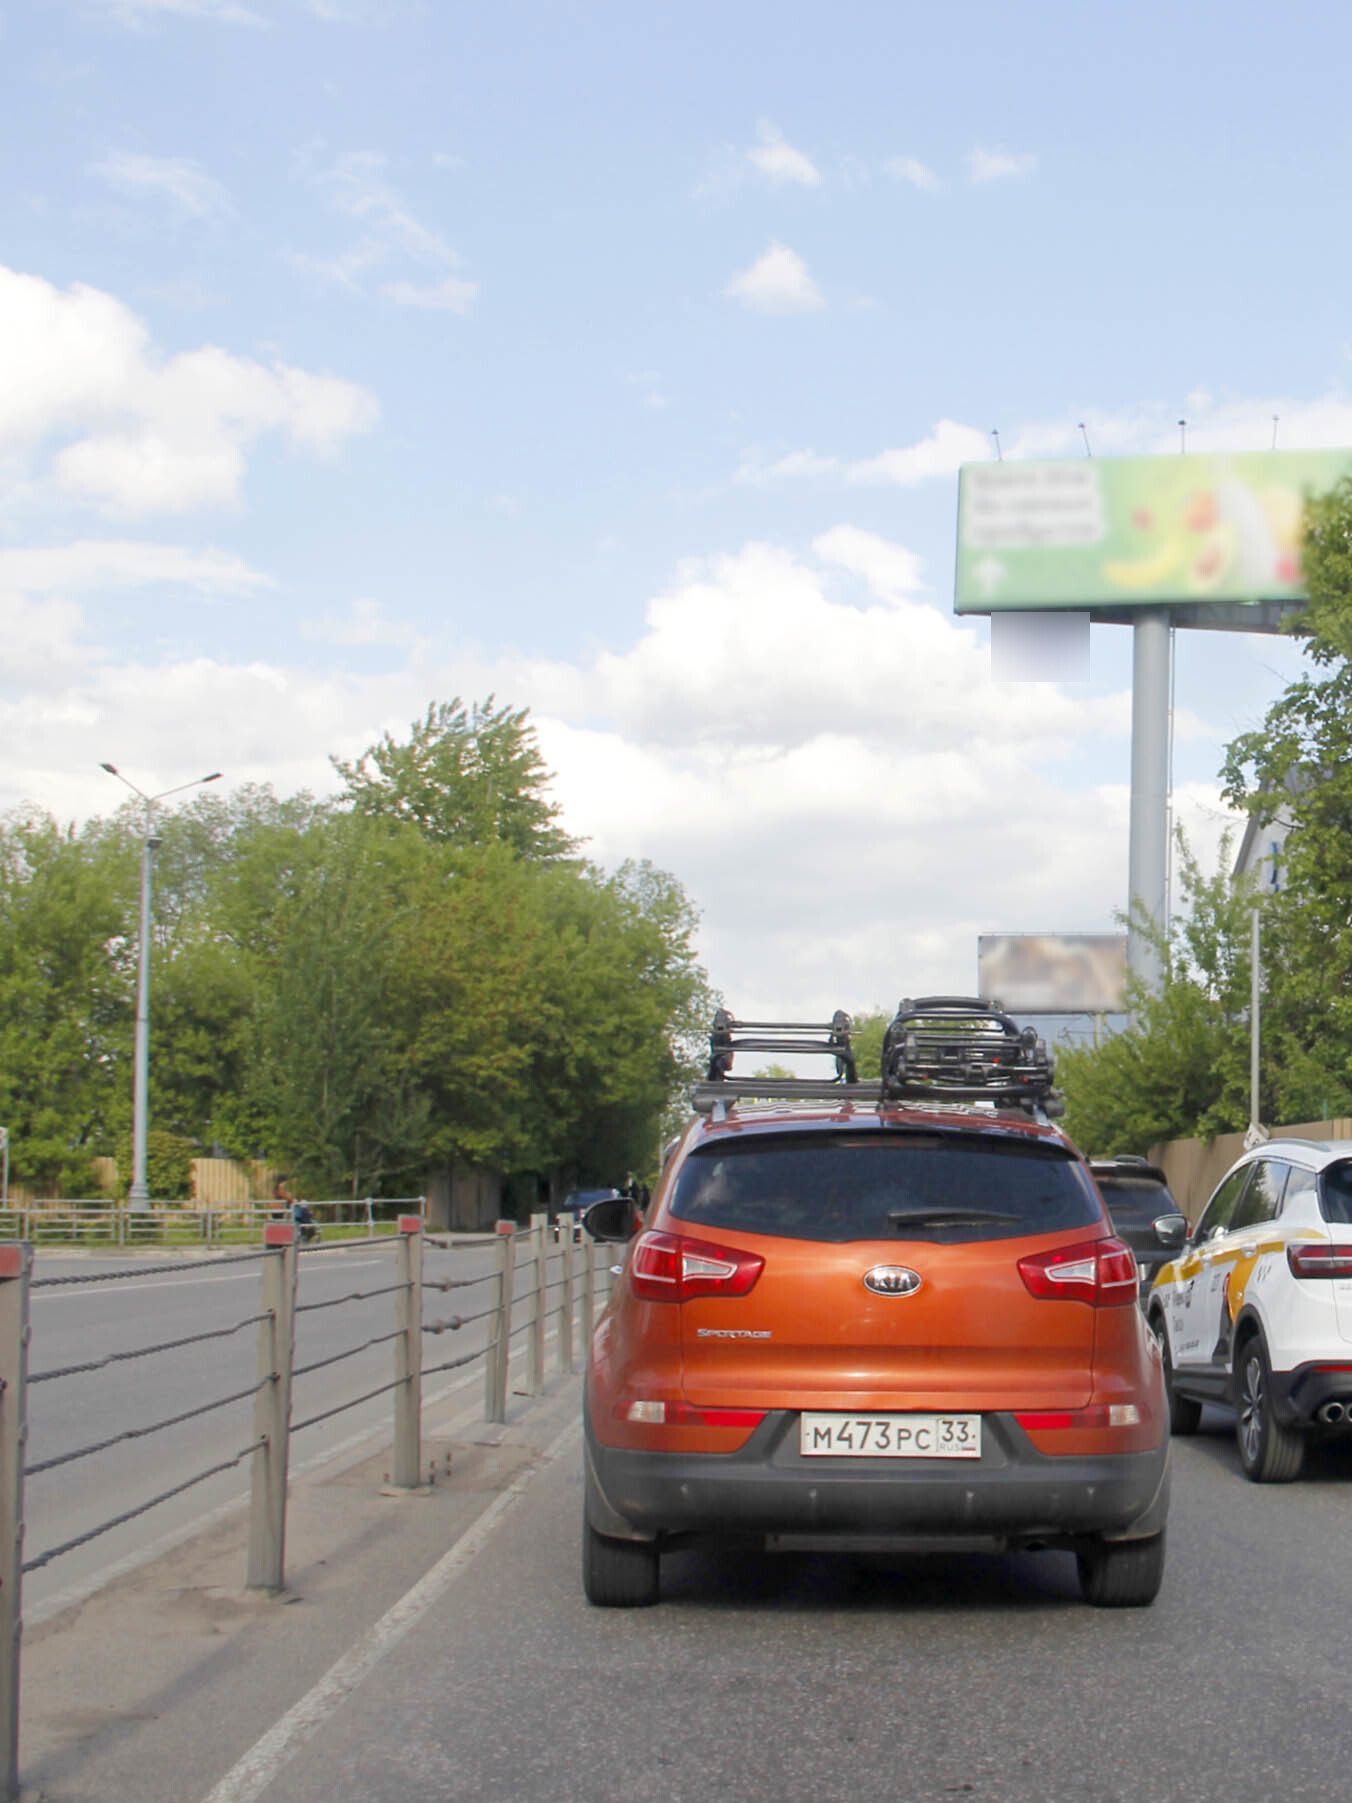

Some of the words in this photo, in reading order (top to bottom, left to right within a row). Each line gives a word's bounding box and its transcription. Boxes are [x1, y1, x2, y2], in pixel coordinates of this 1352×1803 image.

[873, 1271, 913, 1289] KIA
[697, 1328, 772, 1339] SPORTAGE
[941, 1421, 969, 1443] 33
